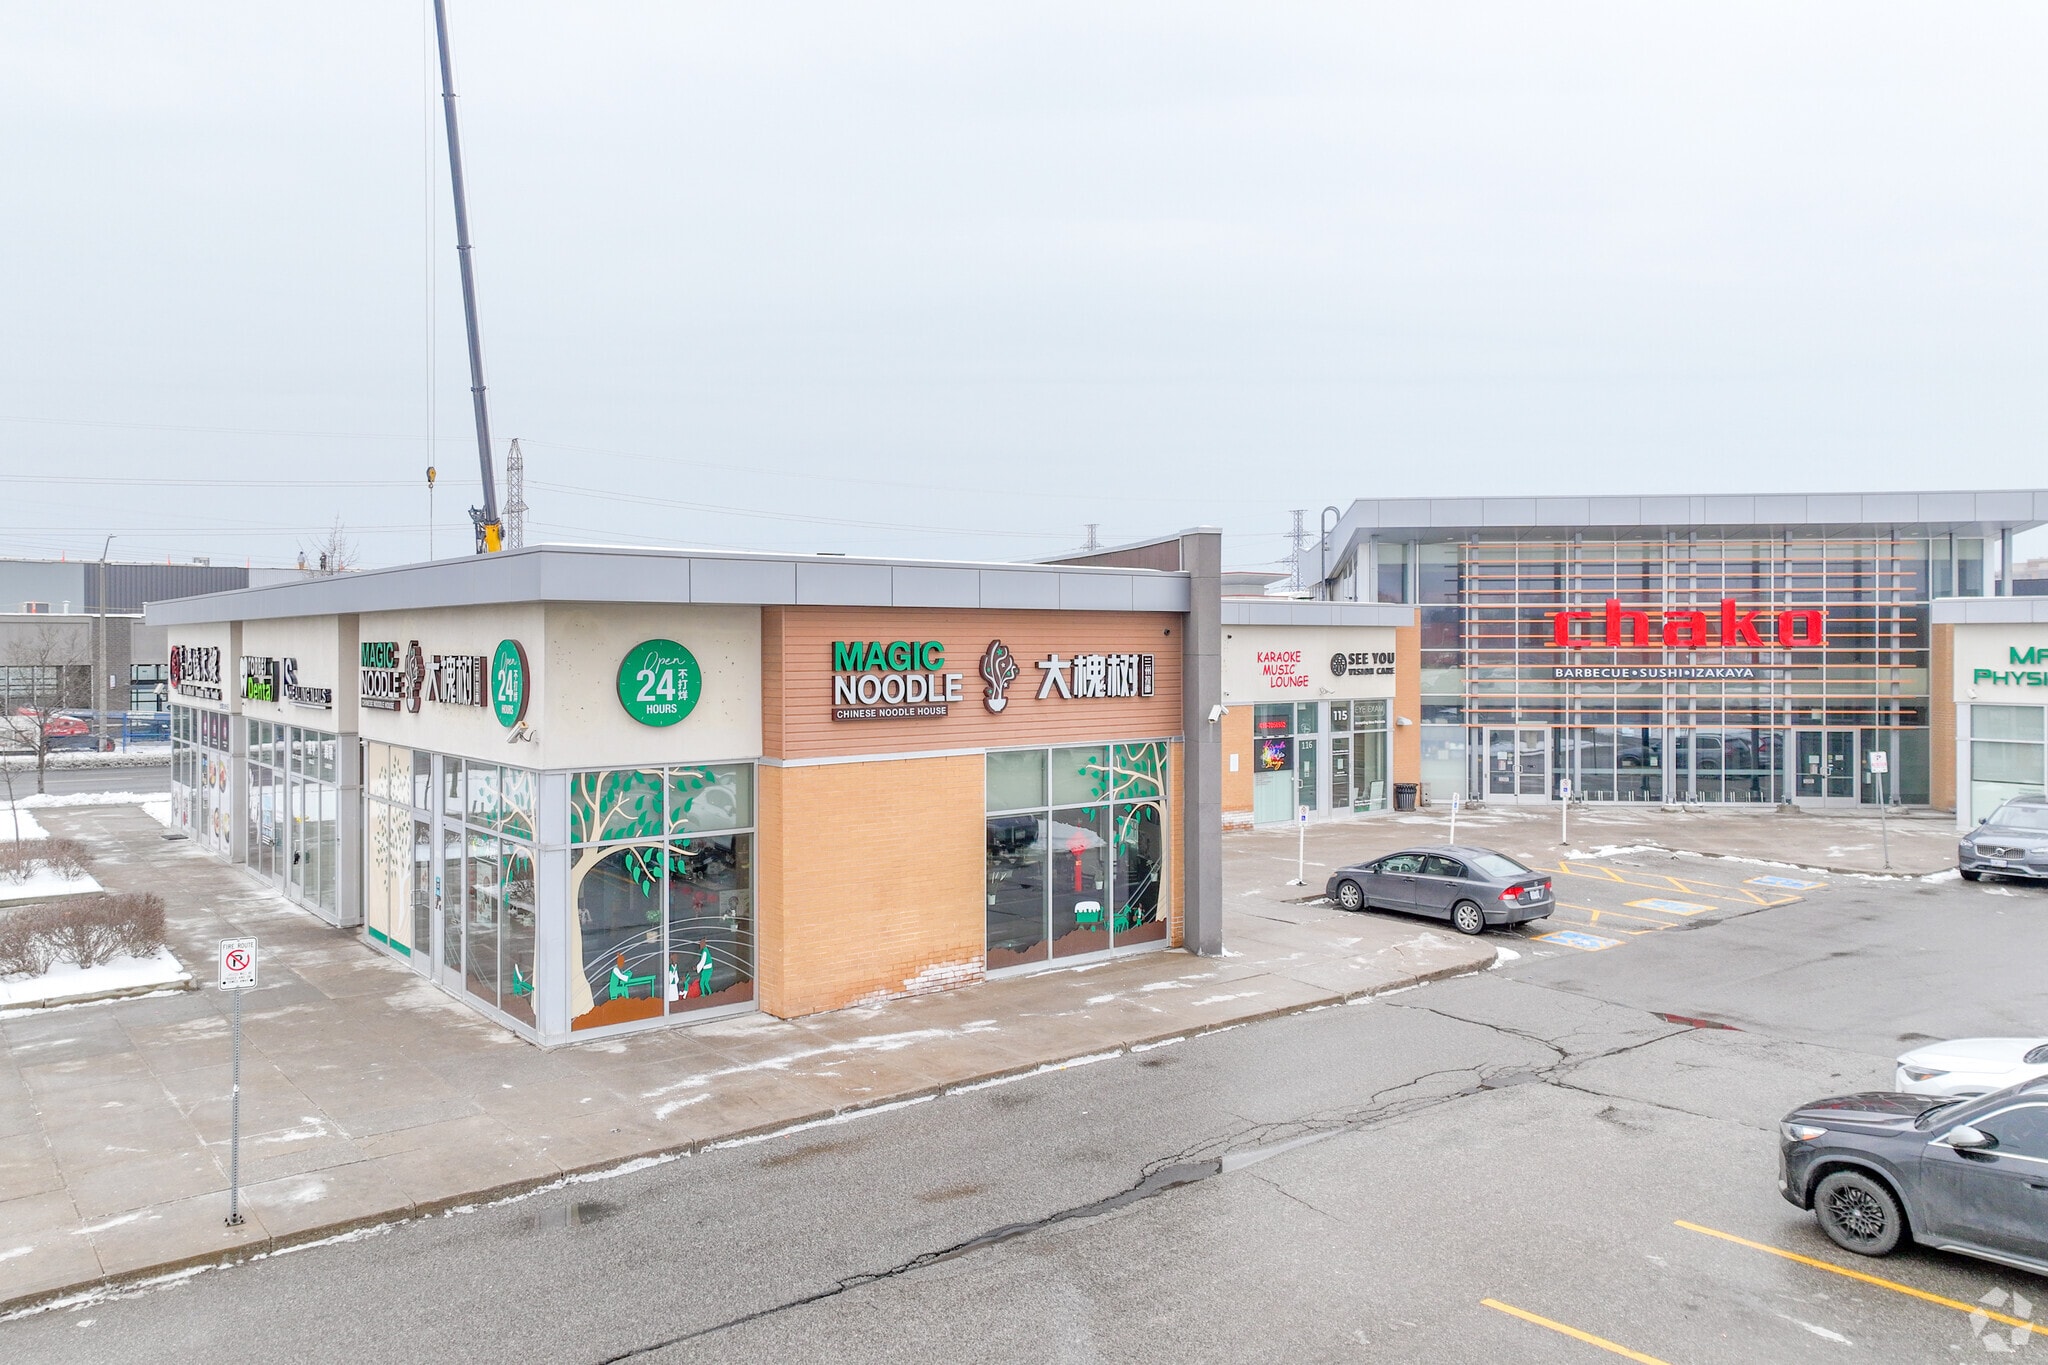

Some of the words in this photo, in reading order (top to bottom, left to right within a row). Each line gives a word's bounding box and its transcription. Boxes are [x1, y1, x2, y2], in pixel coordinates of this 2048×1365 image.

[1553, 598, 1822, 646] chako
[361, 642, 397, 668] MAGIC
[643, 651, 685, 674] Open
[834, 641, 945, 671] MAGIC
[1257, 651, 1301, 663] KARAOKE
[1348, 653, 1368, 665] SEE
[1372, 652, 1395, 664] YOU
[1038, 654, 1139, 698] 大槐树
[1263, 664, 1296, 676] MUSIC
[1270, 675, 1309, 688] LOUNGE
[1555, 668, 1630, 678] BARBECUE
[1640, 668, 1683, 678] SUSHI
[1691, 668, 1754, 678] IZAKAYA
[247, 676, 271, 702] Denta
[361, 670, 402, 698] NOODLE
[498, 670, 514, 702] 24
[636, 669, 676, 702] 24
[678, 668, 688, 700] 不打烊
[835, 674, 963, 704] NOODLE
[646, 704, 677, 714] HOURS
[837, 709, 876, 718] CHINESE
[879, 708, 915, 717] NOODLE
[917, 707, 947, 716] HOUSE
[1333, 710, 1348, 720] 115
[1301, 740, 1313, 749] 116
